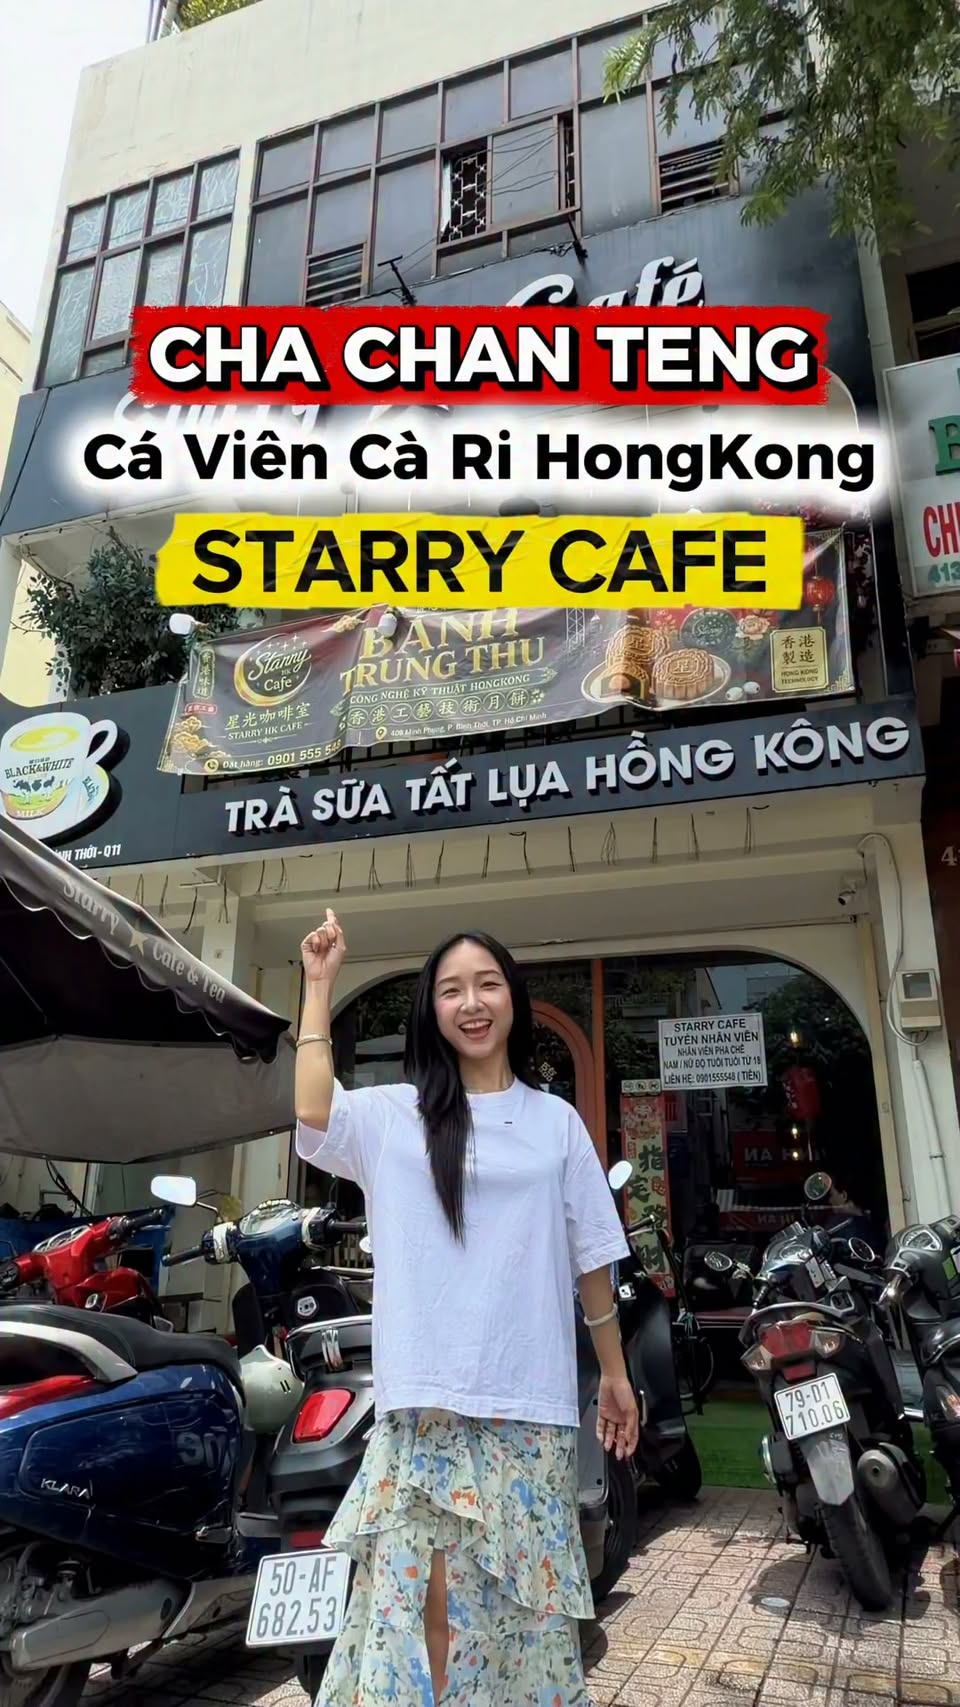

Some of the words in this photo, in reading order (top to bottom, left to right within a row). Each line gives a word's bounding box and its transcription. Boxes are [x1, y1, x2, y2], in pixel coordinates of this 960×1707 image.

[923, 502, 960, 558] CH
[360, 608, 519, 660] BÁNH
[781, 635, 815, 649] 香港
[339, 650, 458, 697] TRUNG
[465, 637, 545, 674] THU
[781, 669, 799, 677] HONG
[800, 668, 819, 676] KONG
[264, 676, 292, 692] Cafe
[350, 693, 378, 704] CÔNG
[381, 689, 409, 701] NGHỆ
[413, 687, 426, 697] KỸ
[431, 684, 467, 697] THUẬT
[470, 674, 530, 691] HONGKONG
[225, 702, 311, 730] 星光咖啡室
[529, 713, 547, 721] Minh
[228, 727, 261, 740] STARRY
[265, 727, 278, 735] HK
[280, 721, 303, 732] CAFE
[267, 752, 295, 766] 0901
[299, 747, 321, 760] 555
[225, 785, 298, 832] TRÀ
[312, 779, 391, 822] SỮA
[405, 758, 472, 812] TẤT
[488, 761, 569, 807] LỤA
[586, 730, 735, 790] HỒNG
[754, 717, 910, 770] KÔNG
[941, 846, 960, 866] 4
[63, 879, 120, 935] Starry
[187, 967, 199, 986] &
[201, 973, 227, 1004] Tea
[674, 1020, 714, 1032] STARRY
[718, 1019, 746, 1029] CAFE
[664, 1033, 698, 1046] TUYỂN
[701, 1032, 731, 1044] NHÂN
[734, 1030, 759, 1042] VIÊN
[678, 1046, 697, 1056] NHÂN
[698, 1045, 714, 1056] VIÊN
[715, 1046, 729, 1055] PHA
[663, 1060, 678, 1069] NAM
[785, 1380, 831, 1412] 79-D1
[785, 1400, 844, 1435] 710.06
[41, 1478, 91, 1499] KLARA
[270, 1556, 337, 1597] 50-AF
[256, 1597, 338, 1639] 682.53
